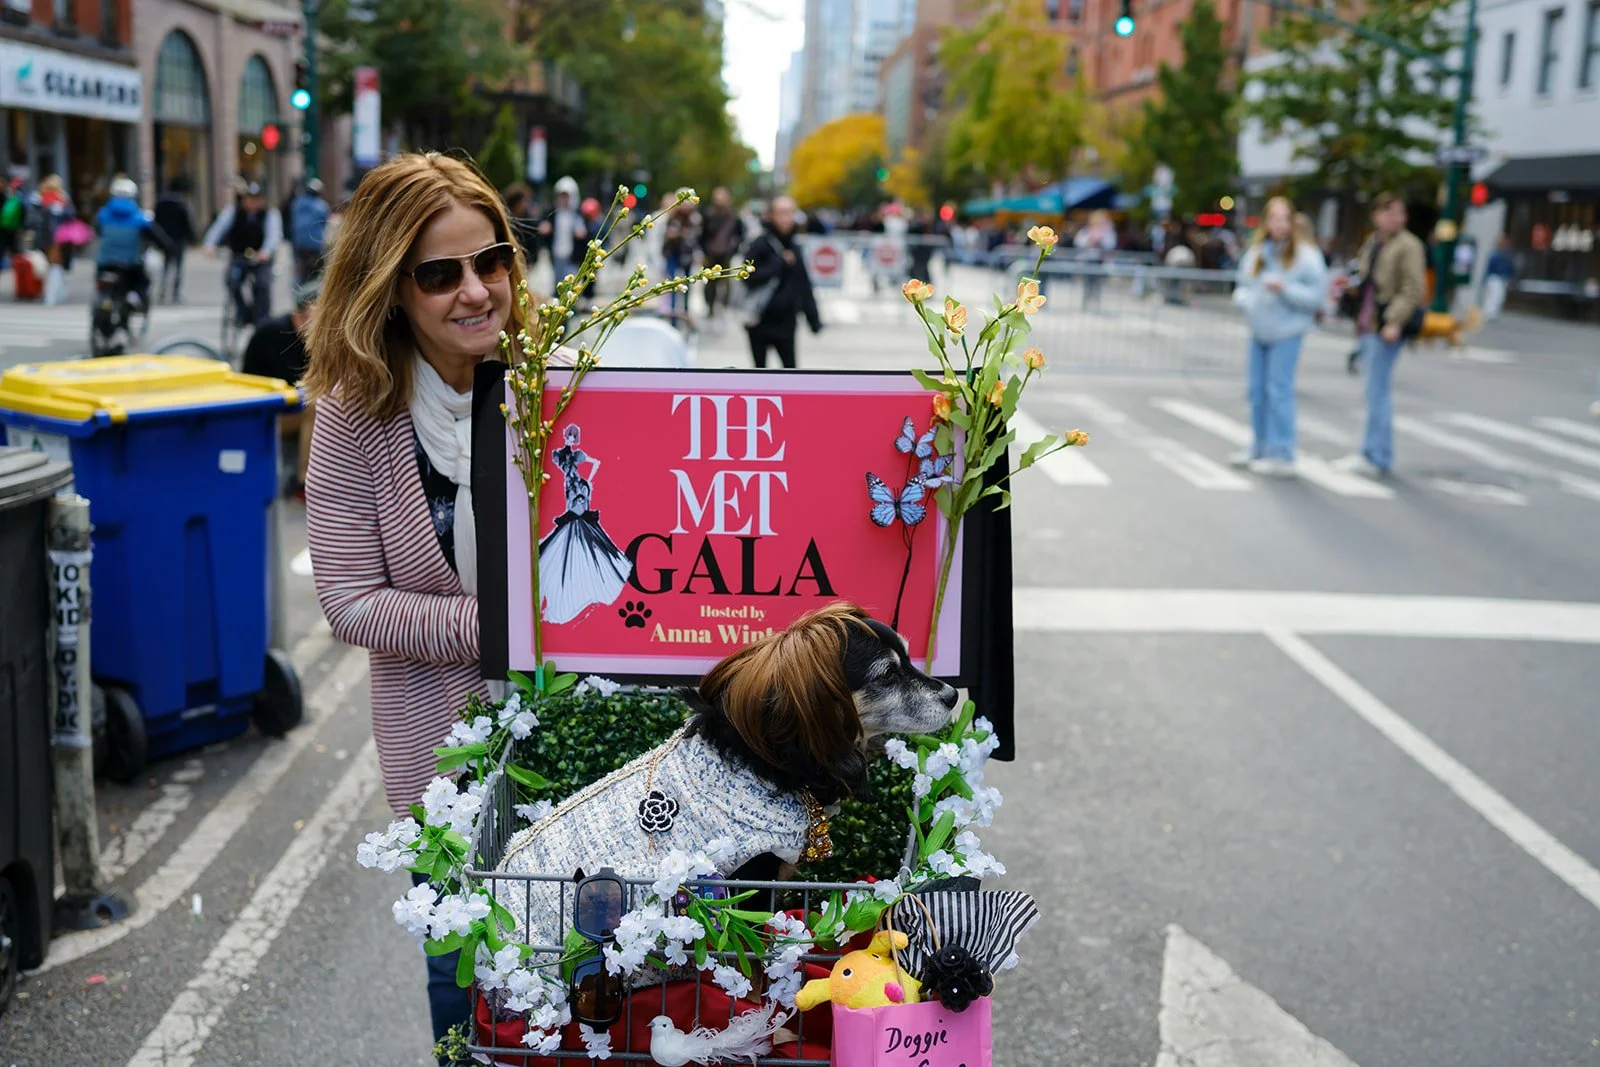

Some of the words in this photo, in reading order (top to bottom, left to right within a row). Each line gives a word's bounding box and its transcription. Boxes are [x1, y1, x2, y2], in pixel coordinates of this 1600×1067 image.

[671, 394, 786, 462] THE
[668, 468, 789, 536] MET
[626, 533, 839, 598] GALA
[650, 622, 712, 644] Anna
[717, 623, 774, 645] Wint
[700, 605, 748, 618] Hosted
[750, 606, 767, 622] by
[885, 1019, 948, 1058] Doggie
